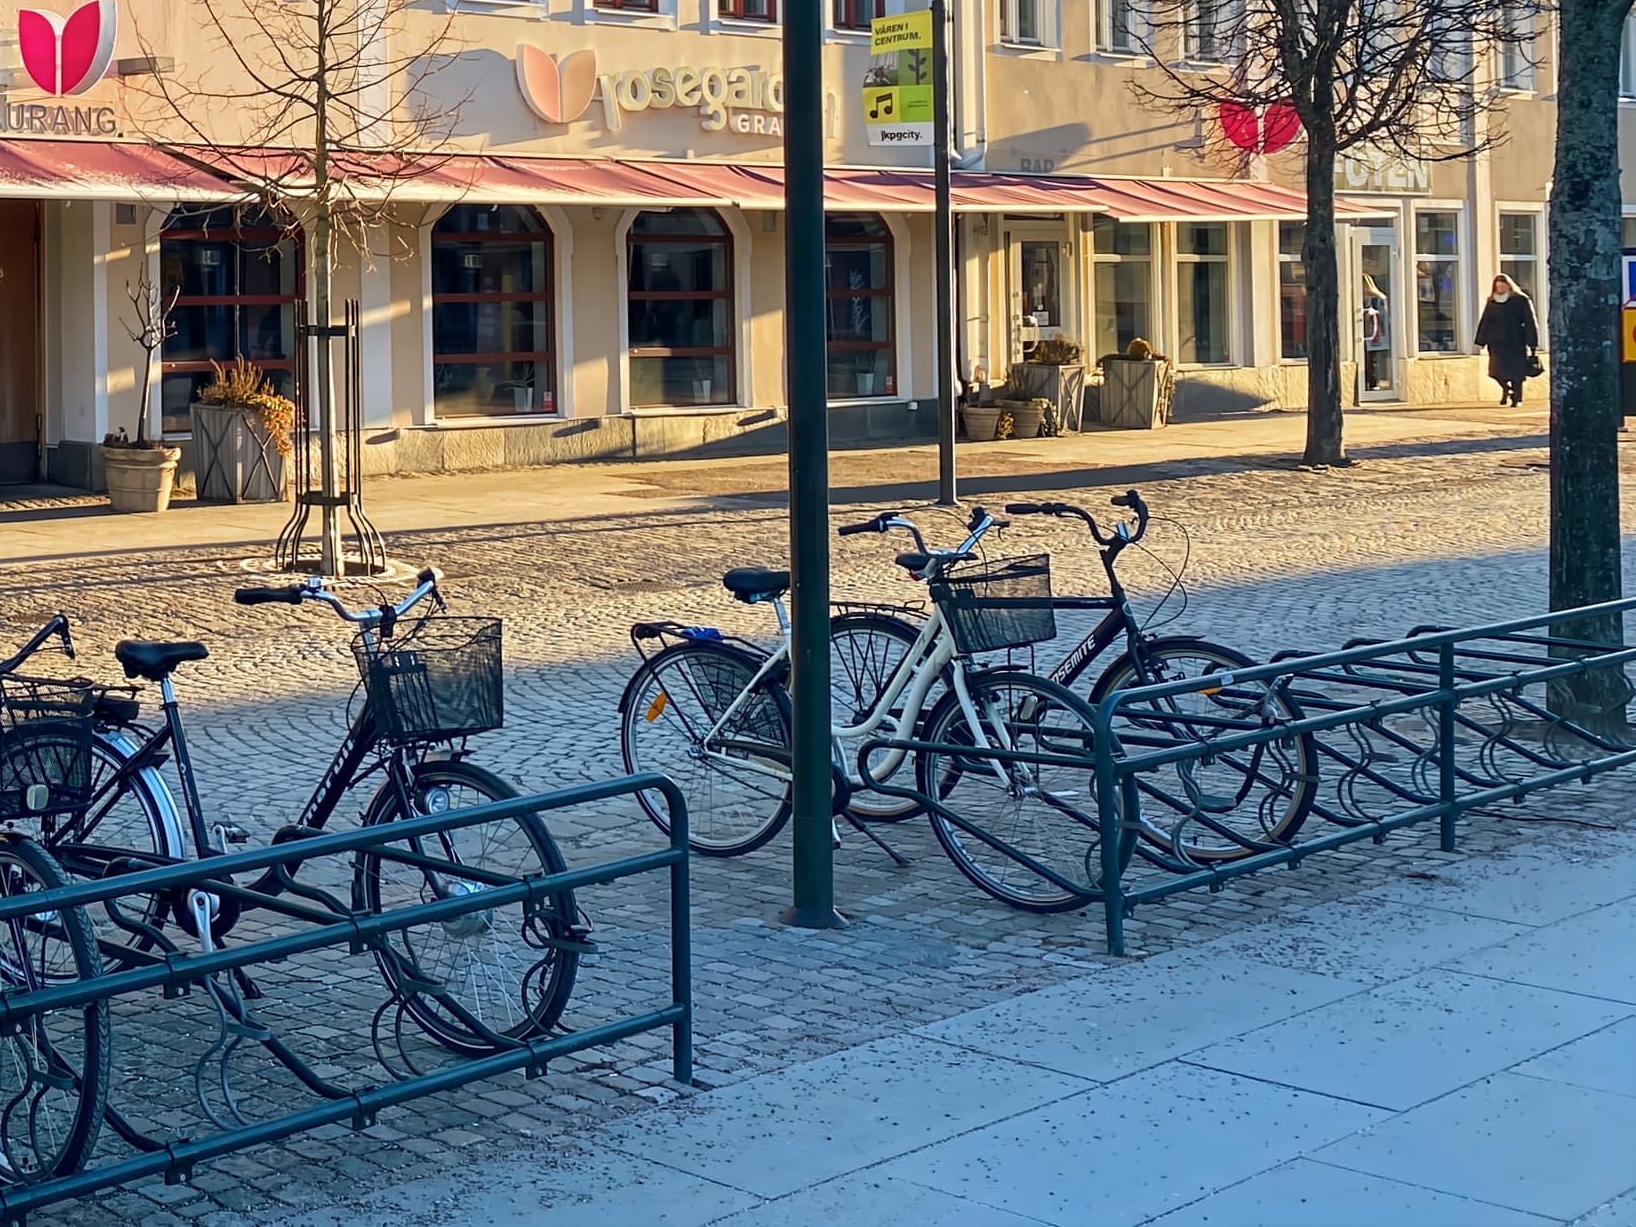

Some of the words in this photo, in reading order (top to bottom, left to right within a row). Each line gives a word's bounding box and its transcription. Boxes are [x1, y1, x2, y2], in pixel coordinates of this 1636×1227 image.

[875, 22, 905, 35] VÅREN
[874, 32, 921, 46] CENTRUM.
[880, 130, 923, 141] jkpgcity.
